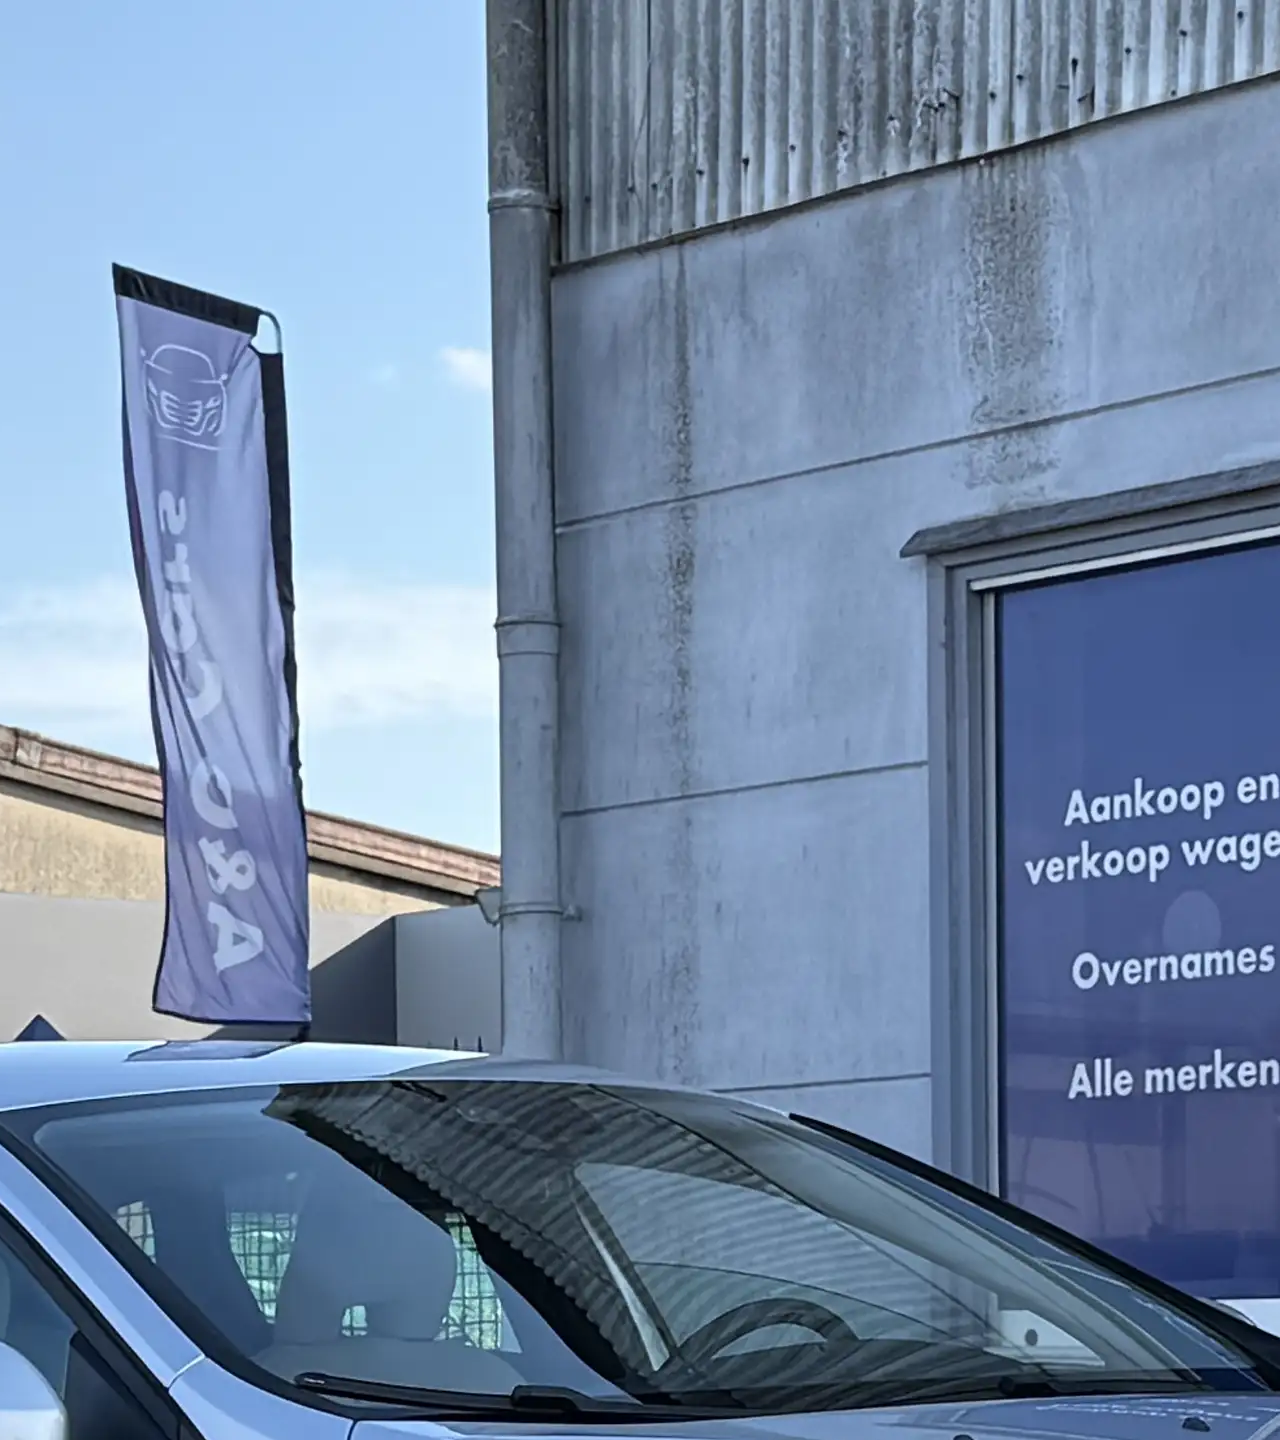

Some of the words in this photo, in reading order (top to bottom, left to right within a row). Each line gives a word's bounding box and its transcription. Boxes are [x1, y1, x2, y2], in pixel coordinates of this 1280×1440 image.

[1064, 777, 1224, 826] Aankoop
[1236, 773, 1280, 804] en
[1025, 840, 1170, 885] verkoop
[1072, 944, 1275, 989] Overnames
[1068, 1058, 1134, 1099] Alle
[1144, 1048, 1280, 1094] merken
